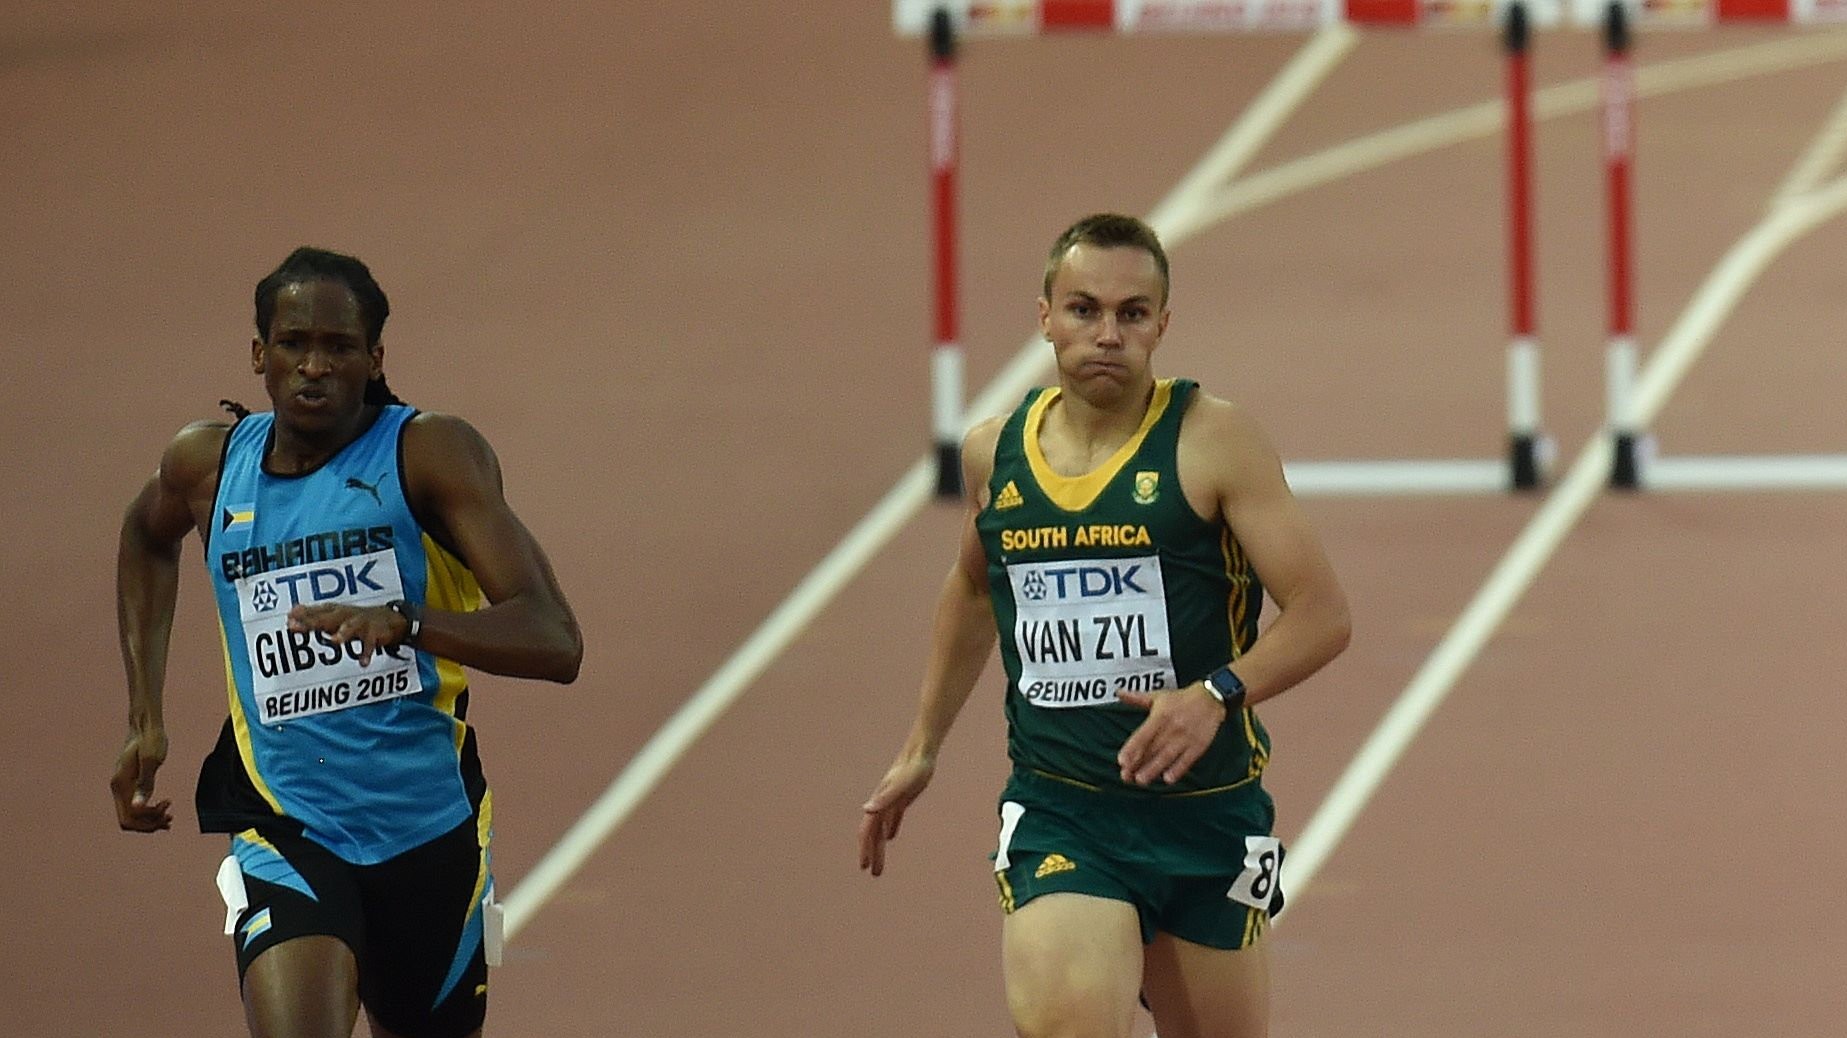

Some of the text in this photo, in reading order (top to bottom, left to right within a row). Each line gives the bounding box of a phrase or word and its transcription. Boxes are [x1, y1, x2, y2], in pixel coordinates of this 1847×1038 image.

[222, 526, 393, 583] BAHAMAS
[1002, 525, 1152, 550] SOUTH AFRICA
[275, 559, 384, 609] TDK
[1045, 565, 1147, 599] TDK
[1022, 614, 1158, 664] VAN ZYL
[266, 669, 409, 718] BEIJING 2015
[1026, 677, 1107, 702] BEIJING
[1251, 850, 1275, 899] 8
